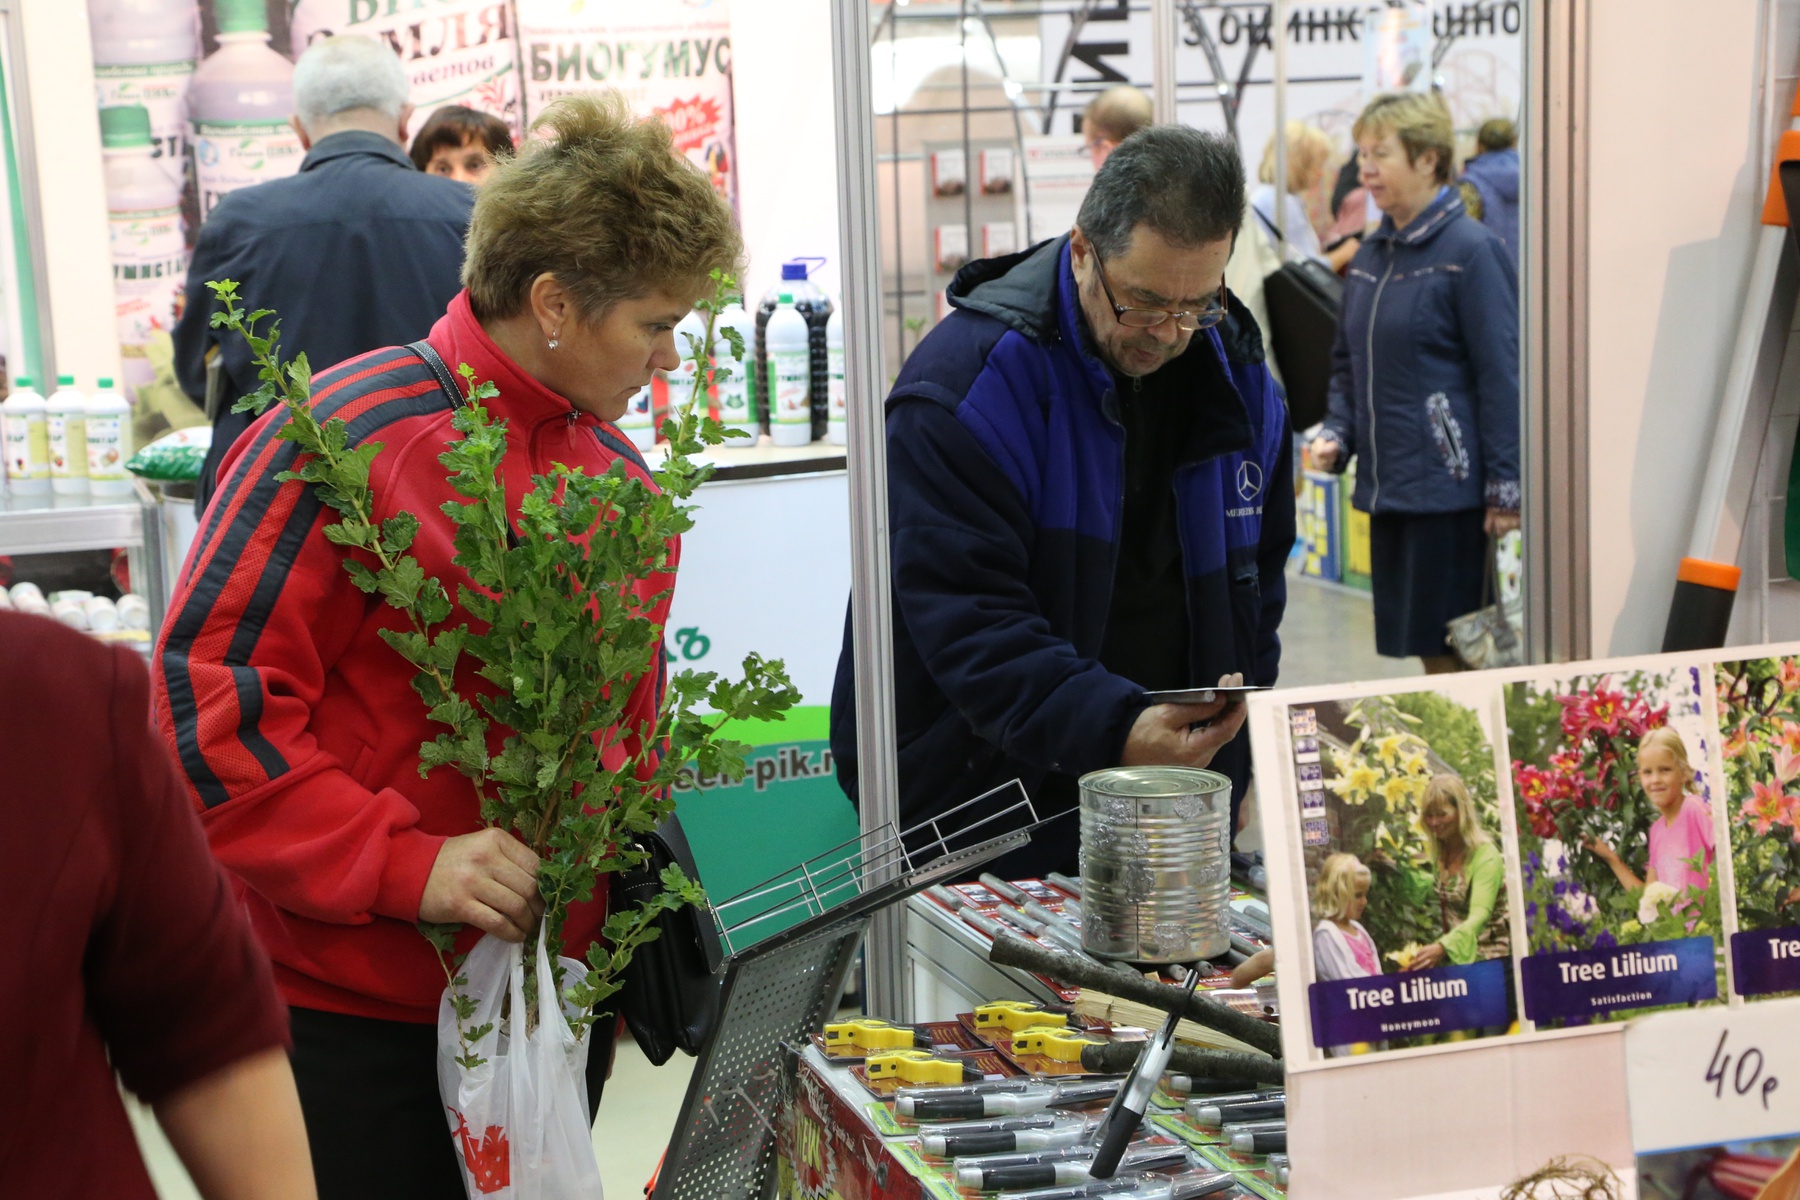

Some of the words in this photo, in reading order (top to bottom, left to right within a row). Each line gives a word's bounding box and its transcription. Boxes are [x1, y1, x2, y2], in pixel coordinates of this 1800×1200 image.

[530, 36, 731, 82] БИОГУМУС
[1558, 961, 1606, 984] Tree
[1611, 951, 1678, 978] Lilium
[1346, 987, 1395, 1010] Tree
[1401, 976, 1468, 1004] Lilium
[1590, 991, 1653, 1007] Satisfaction
[1380, 1017, 1441, 1033] Honeymoon
